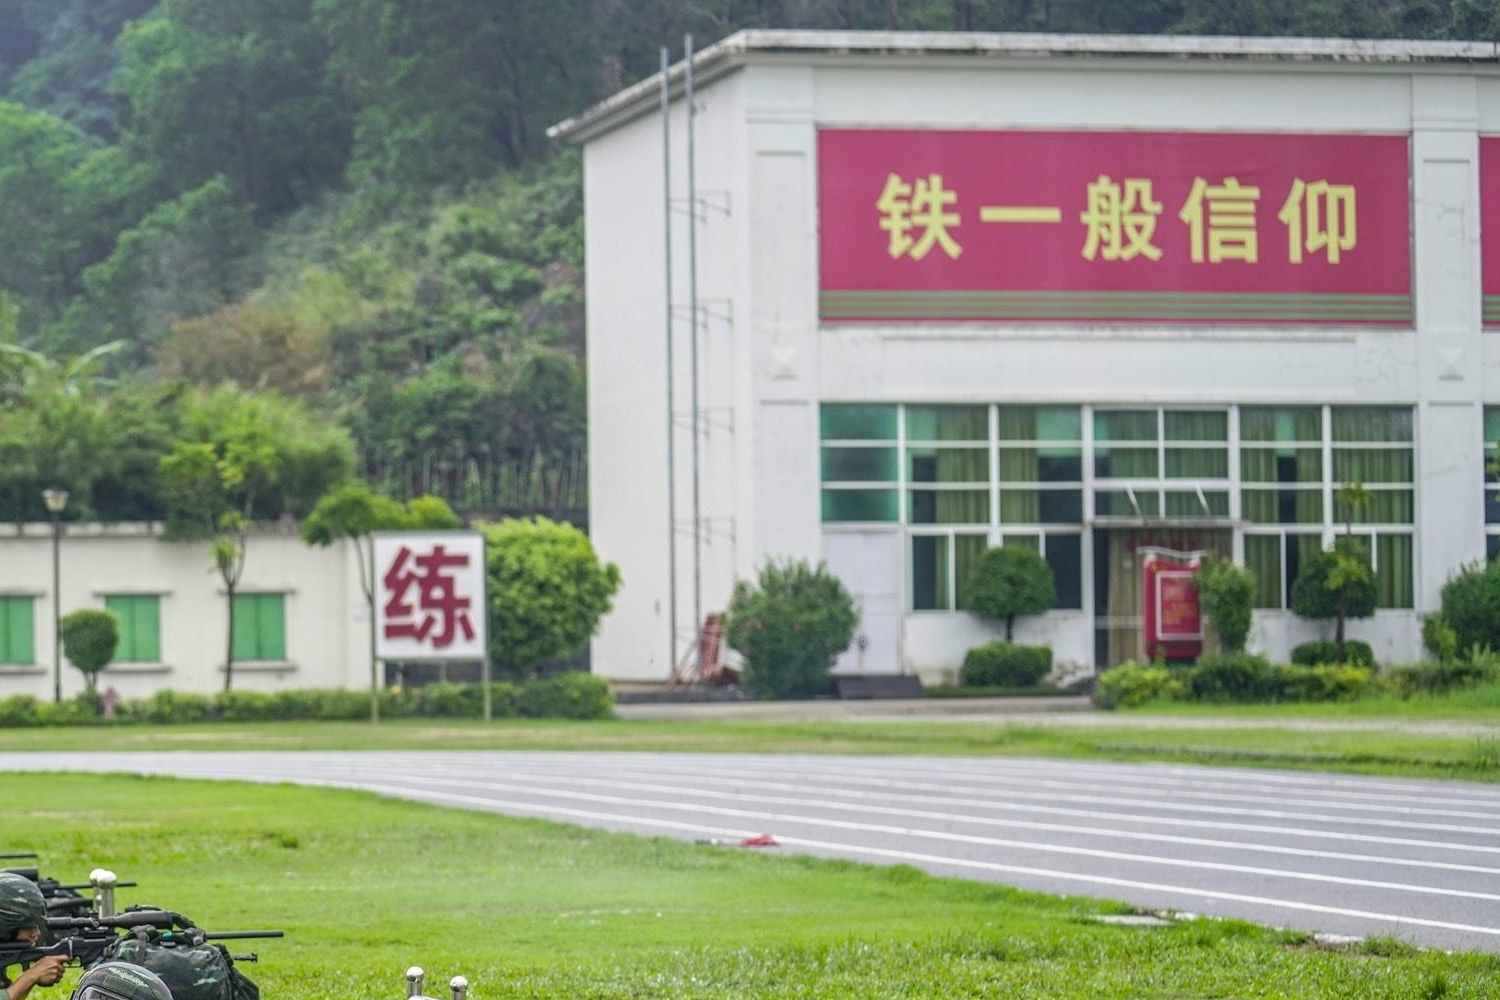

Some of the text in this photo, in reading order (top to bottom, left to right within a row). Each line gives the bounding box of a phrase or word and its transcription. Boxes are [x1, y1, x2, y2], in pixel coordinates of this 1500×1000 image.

[876, 173, 1358, 265] 铁一般信仰
[384, 545, 474, 649] 练
